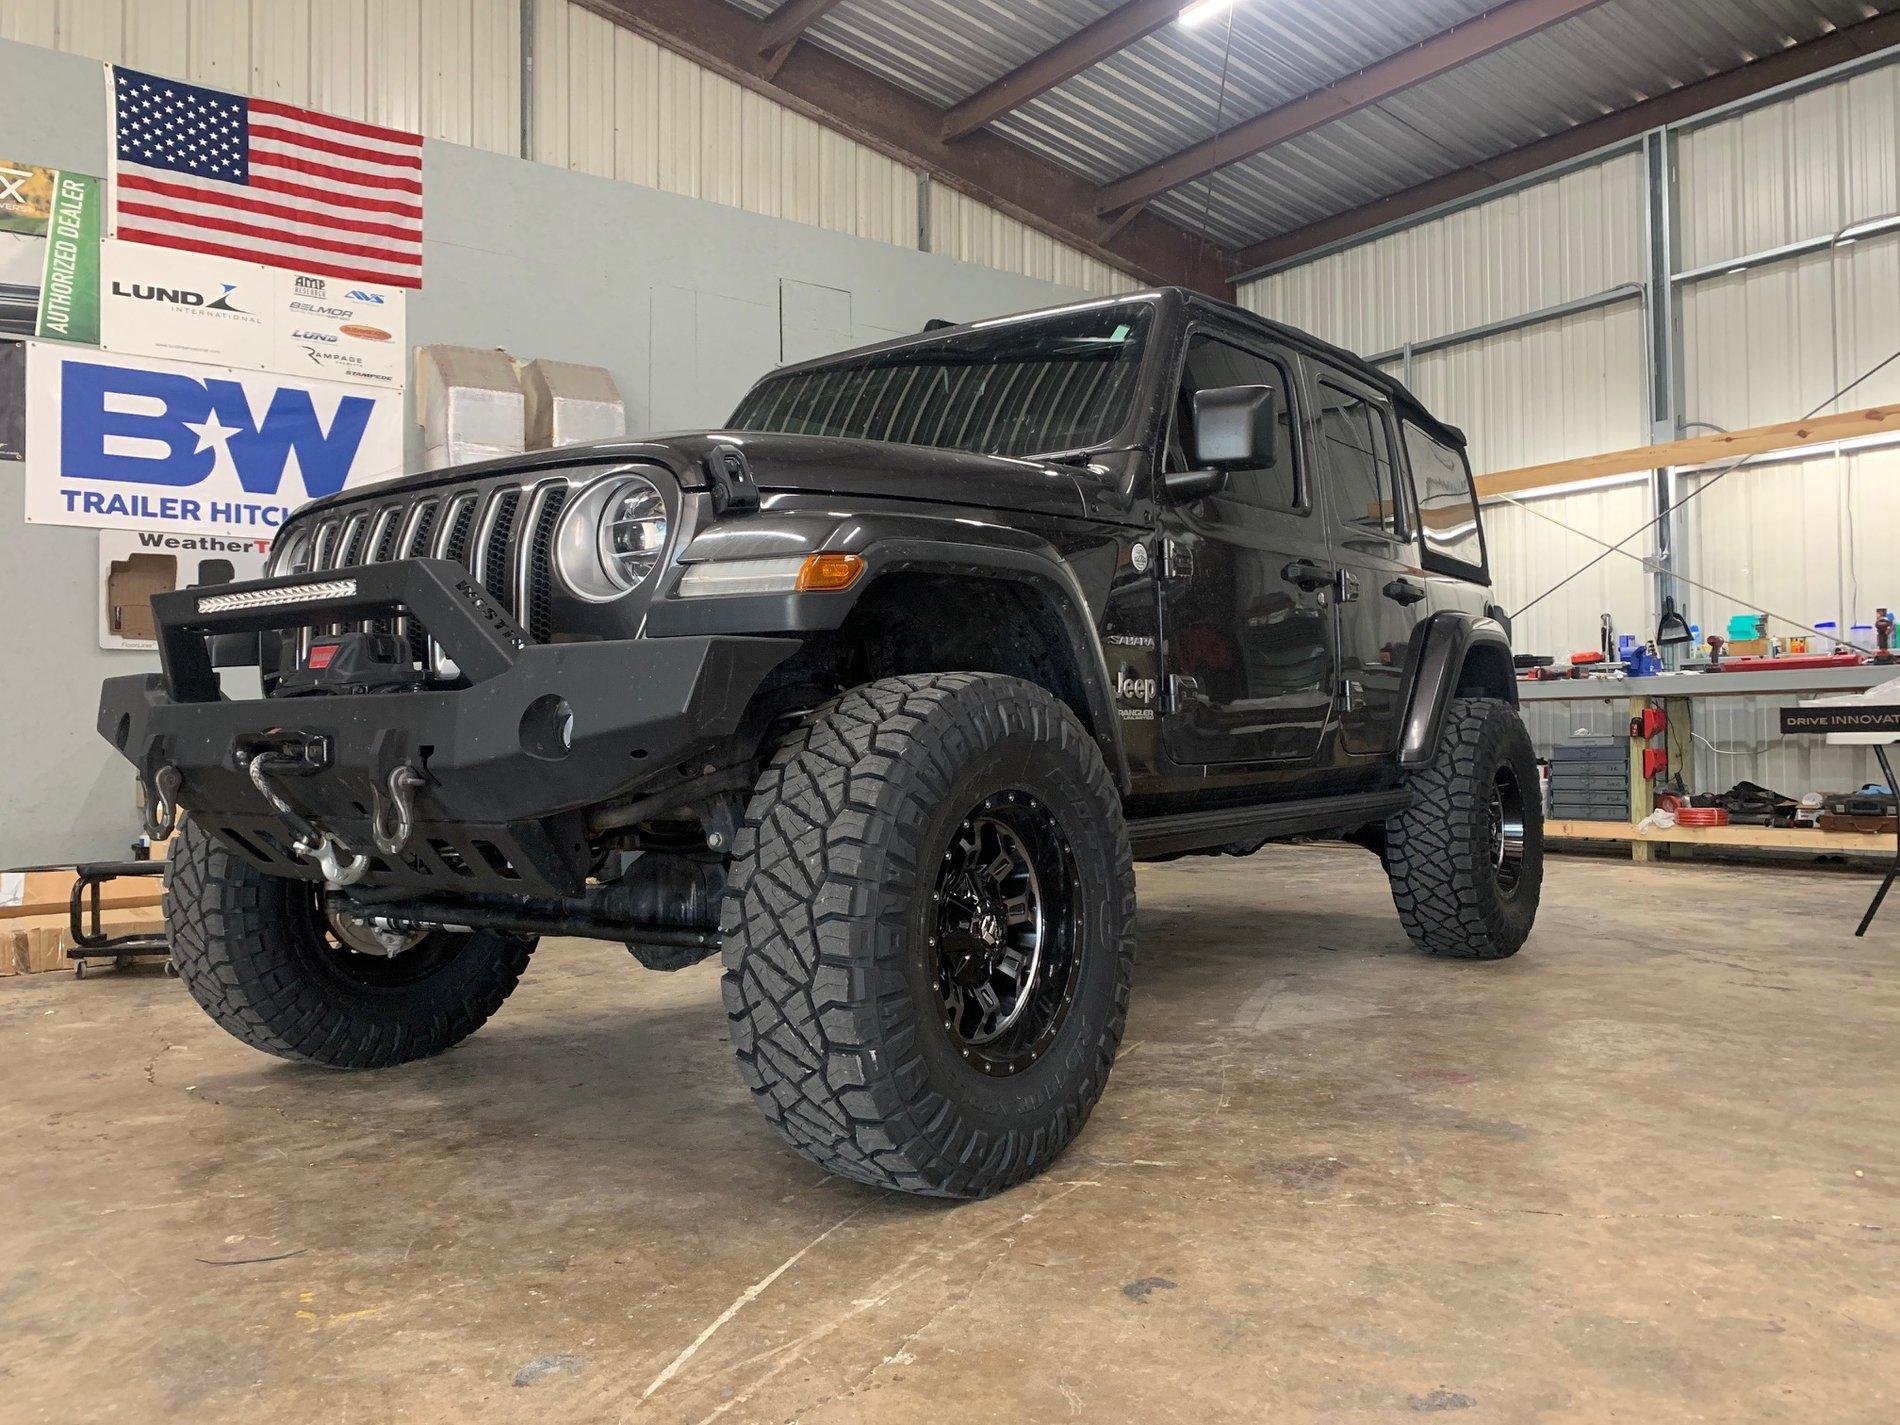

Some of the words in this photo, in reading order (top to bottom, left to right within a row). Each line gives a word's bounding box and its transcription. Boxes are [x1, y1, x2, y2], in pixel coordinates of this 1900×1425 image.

[57, 179, 85, 240] DEALER
[46, 240, 78, 334] AUTHORIZED
[295, 276, 325, 290] AMP
[112, 281, 204, 306] LUND
[171, 306, 262, 324] INTERNATIONAL
[289, 301, 353, 318] BELMOR
[292, 329, 338, 343] LUND
[300, 345, 363, 367] RAMPAGE
[345, 370, 393, 381] STAMPEDE
[61, 489, 200, 521] TRAILER
[139, 532, 269, 553] WeatherT
[1107, 635, 1155, 648] SAHARA
[1115, 671, 1156, 703] Jeep
[1119, 709, 1154, 717] RANGLER
[1787, 717, 1828, 726] DRIVE
[1831, 714, 1900, 725] INNOVAT
